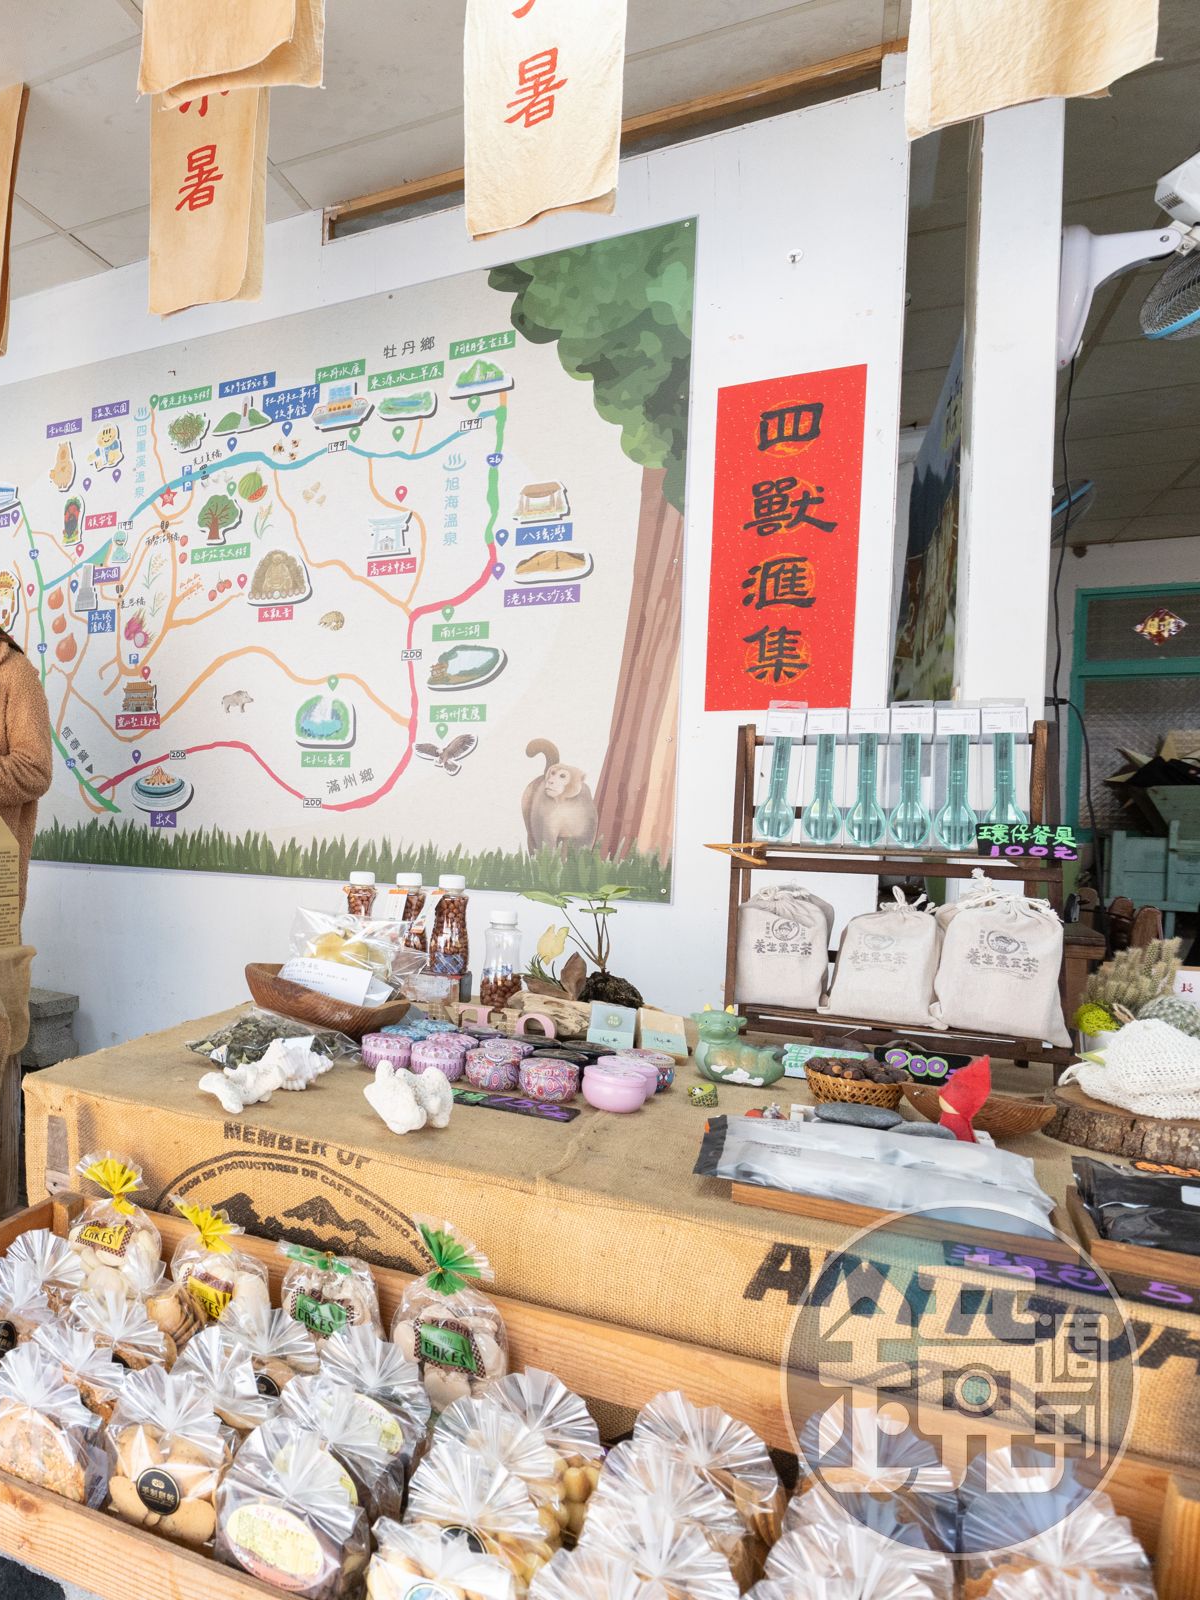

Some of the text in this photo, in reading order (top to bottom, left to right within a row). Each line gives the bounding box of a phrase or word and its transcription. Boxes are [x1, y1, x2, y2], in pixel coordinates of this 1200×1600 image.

[383, 336, 435, 359] 牡丹鄉
[317, 364, 362, 380] 牡丹水庫
[371, 366, 441, 388] 東源水上草原
[266, 387, 318, 406] 牡丹社事件
[134, 425, 148, 498] 四重溪溫泉
[444, 477, 459, 546] 旭海溫泉
[326, 768, 374, 794] 滿州鄉
[977, 824, 1077, 847] 環保餐具
[223, 1120, 327, 1157] MEMBER
[218, 1160, 298, 1176] PRODUCTORES
[83, 1228, 114, 1245] CAKES
[298, 1307, 334, 1333] CAKES
[423, 1340, 466, 1367] CAKES
